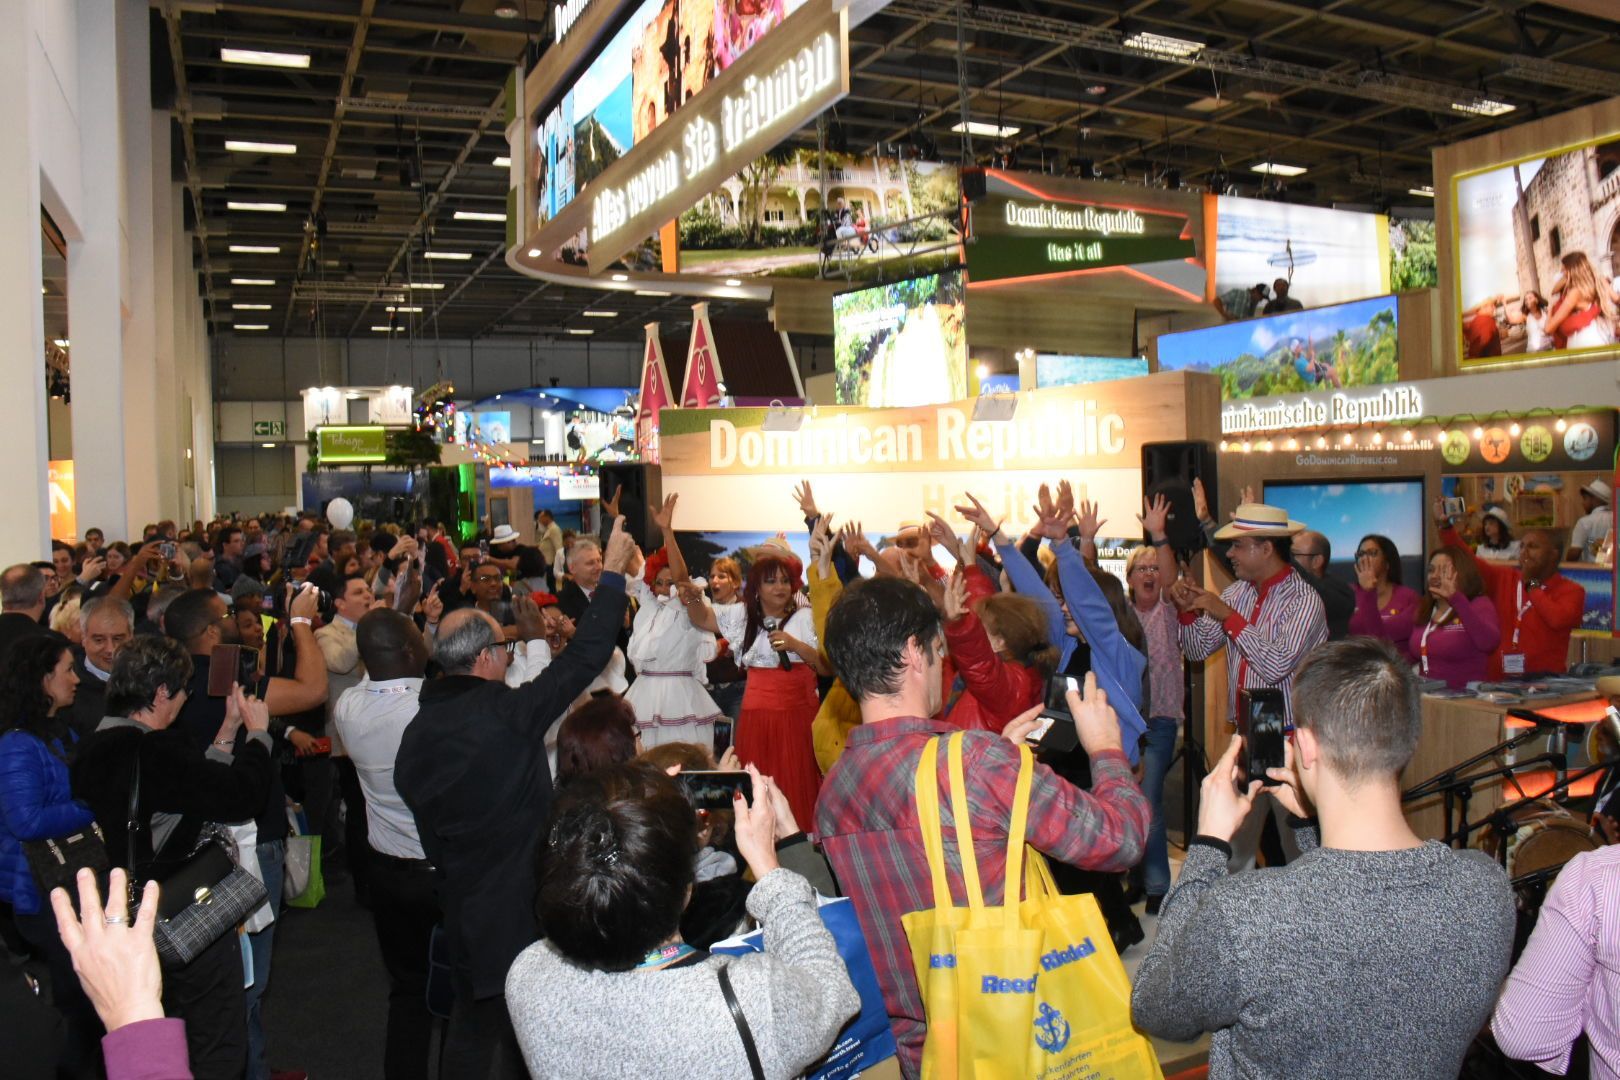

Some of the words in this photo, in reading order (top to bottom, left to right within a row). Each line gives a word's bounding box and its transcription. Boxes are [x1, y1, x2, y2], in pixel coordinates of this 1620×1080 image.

[592, 188, 627, 243] Alles
[682, 115, 717, 180] Sie
[721, 31, 836, 153] träumen
[1006, 200, 1084, 230] Dominican
[1085, 207, 1145, 235] Republic
[1048, 243, 1072, 261] Has
[1074, 243, 1085, 260] it
[1086, 242, 1102, 260] all
[1331, 386, 1422, 424] Republik
[711, 412, 922, 468] Dominican
[937, 399, 1125, 470] Republic
[1040, 936, 1096, 972] Riedel
